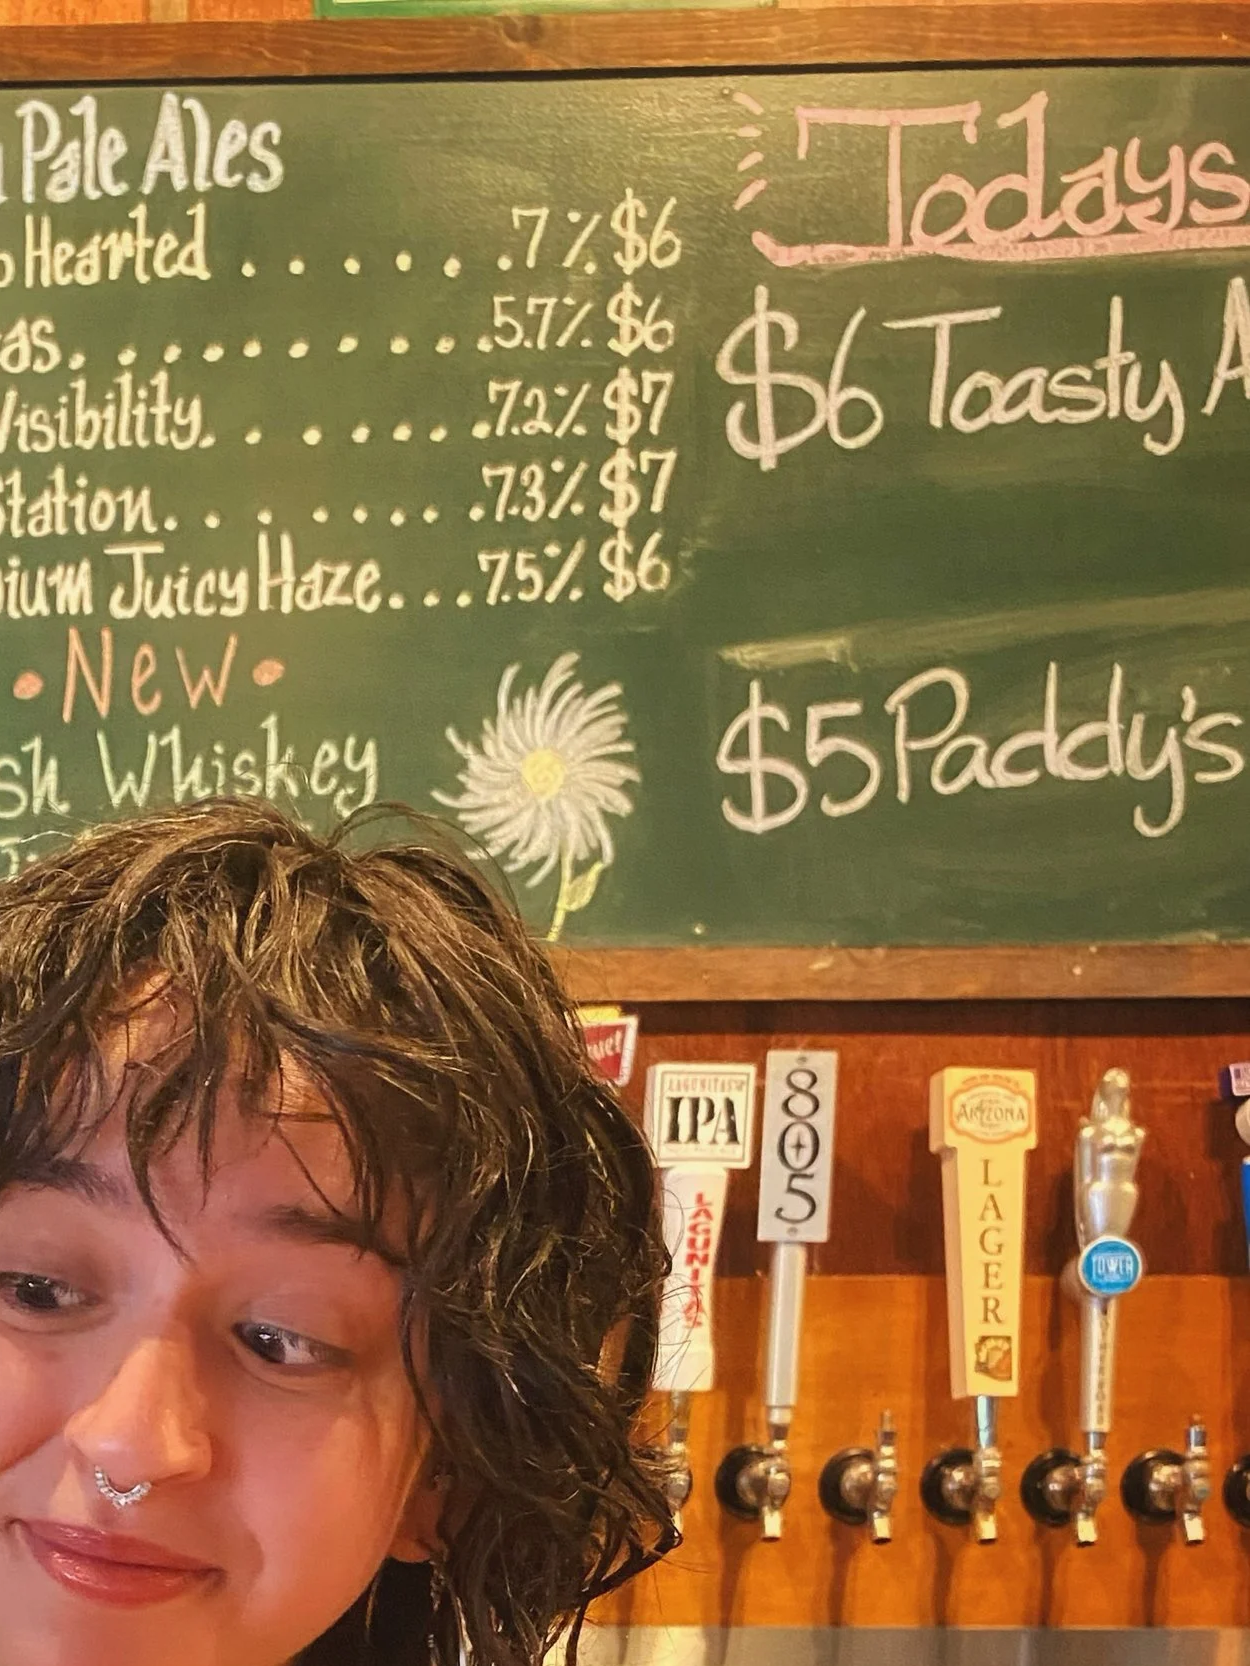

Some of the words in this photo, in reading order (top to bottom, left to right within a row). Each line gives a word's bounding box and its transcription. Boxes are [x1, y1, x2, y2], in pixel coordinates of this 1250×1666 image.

[16, 94, 129, 203] Pale
[141, 92, 285, 194] Ales
[796, 90, 1250, 252] Todays
[23, 203, 212, 289] Hearted
[610, 187, 683, 275] $6
[607, 280, 676, 358] $6
[602, 366, 675, 446] $7
[715, 284, 884, 471] $6
[881, 295, 1186, 457] Toasty
[598, 446, 678, 529] $7
[104, 541, 248, 620] Juicy
[257, 531, 383, 614] Haze
[598, 527, 671, 603] $6
[62, 625, 238, 723] New
[97, 713, 378, 820] Whiskey
[715, 679, 883, 834] $5
[884, 660, 1246, 838] Paddy's
[664, 1096, 741, 1145] IPA
[774, 1067, 821, 1225] 805
[977, 1157, 1006, 1327] LAGER
